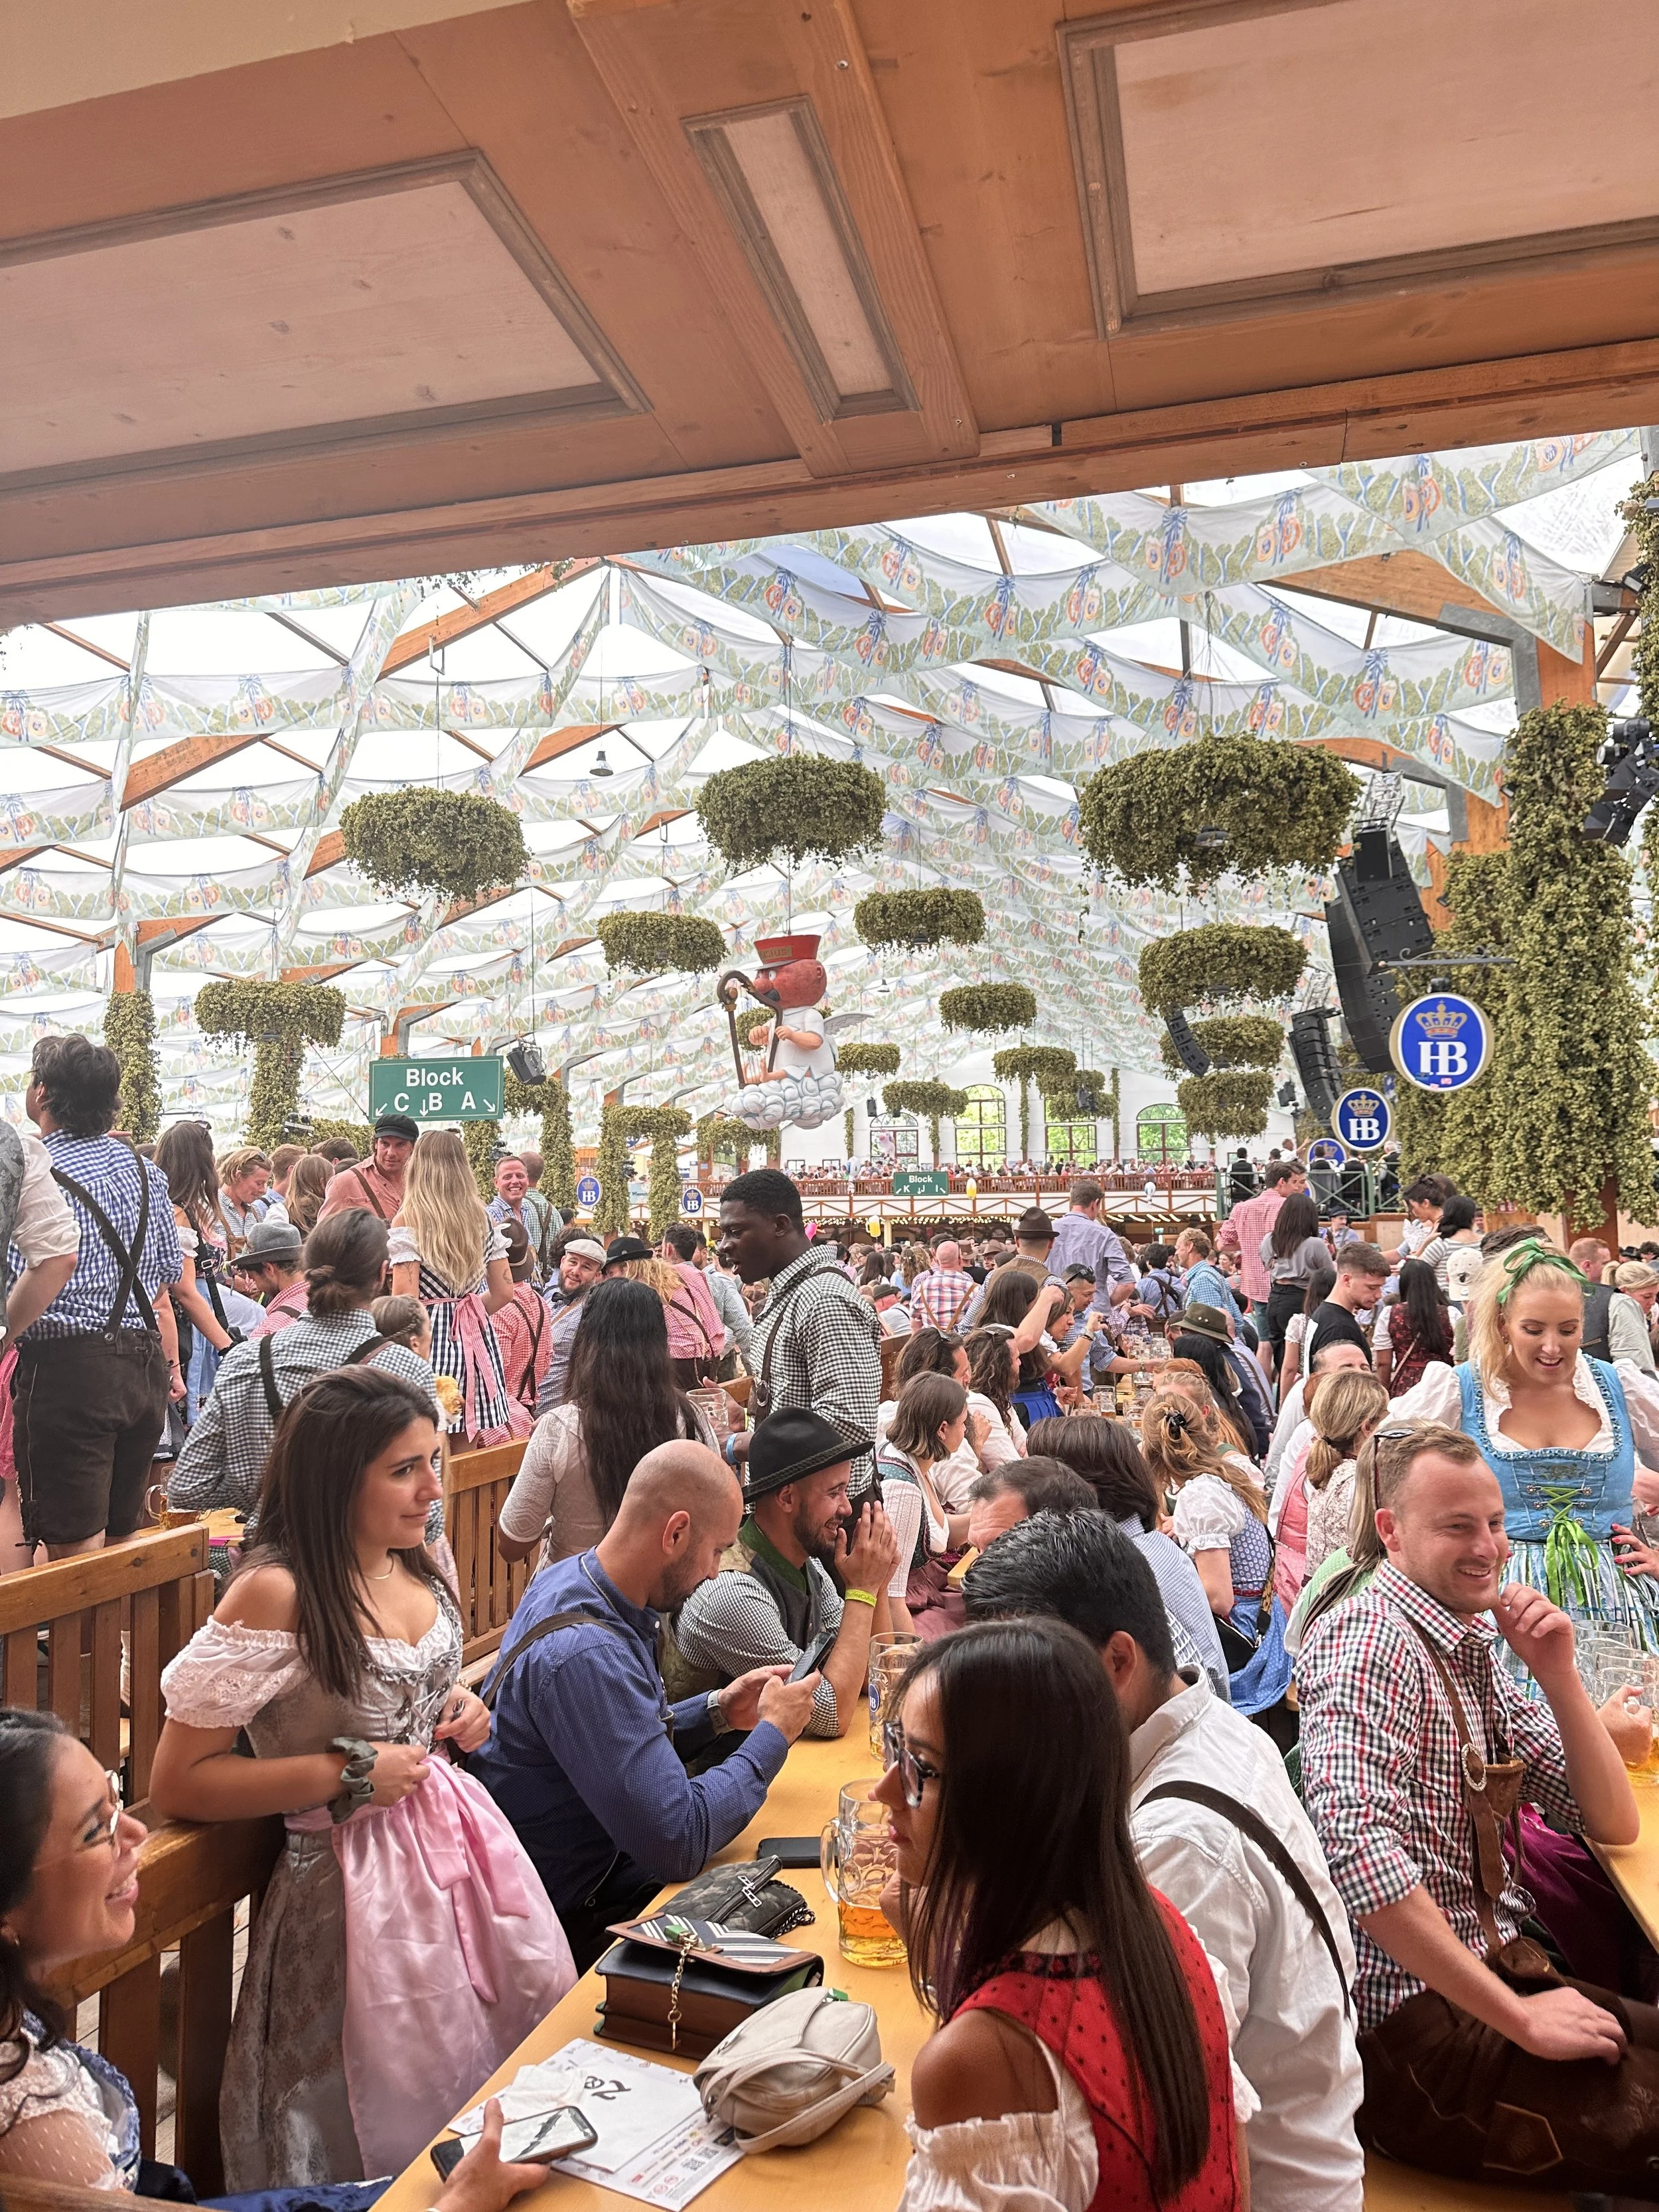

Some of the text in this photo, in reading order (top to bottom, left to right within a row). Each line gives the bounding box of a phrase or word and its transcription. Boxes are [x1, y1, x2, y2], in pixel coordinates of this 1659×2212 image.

[1417, 1041, 1468, 1076] HB
[406, 1067, 464, 1087] Block
[394, 1091, 476, 1112] C B A
[1348, 1118, 1380, 1141] HB
[908, 1175, 933, 1183] Block
[582, 1191, 596, 1202] HB
[903, 1185, 910, 1193] K
[687, 1200, 699, 1211] HB
